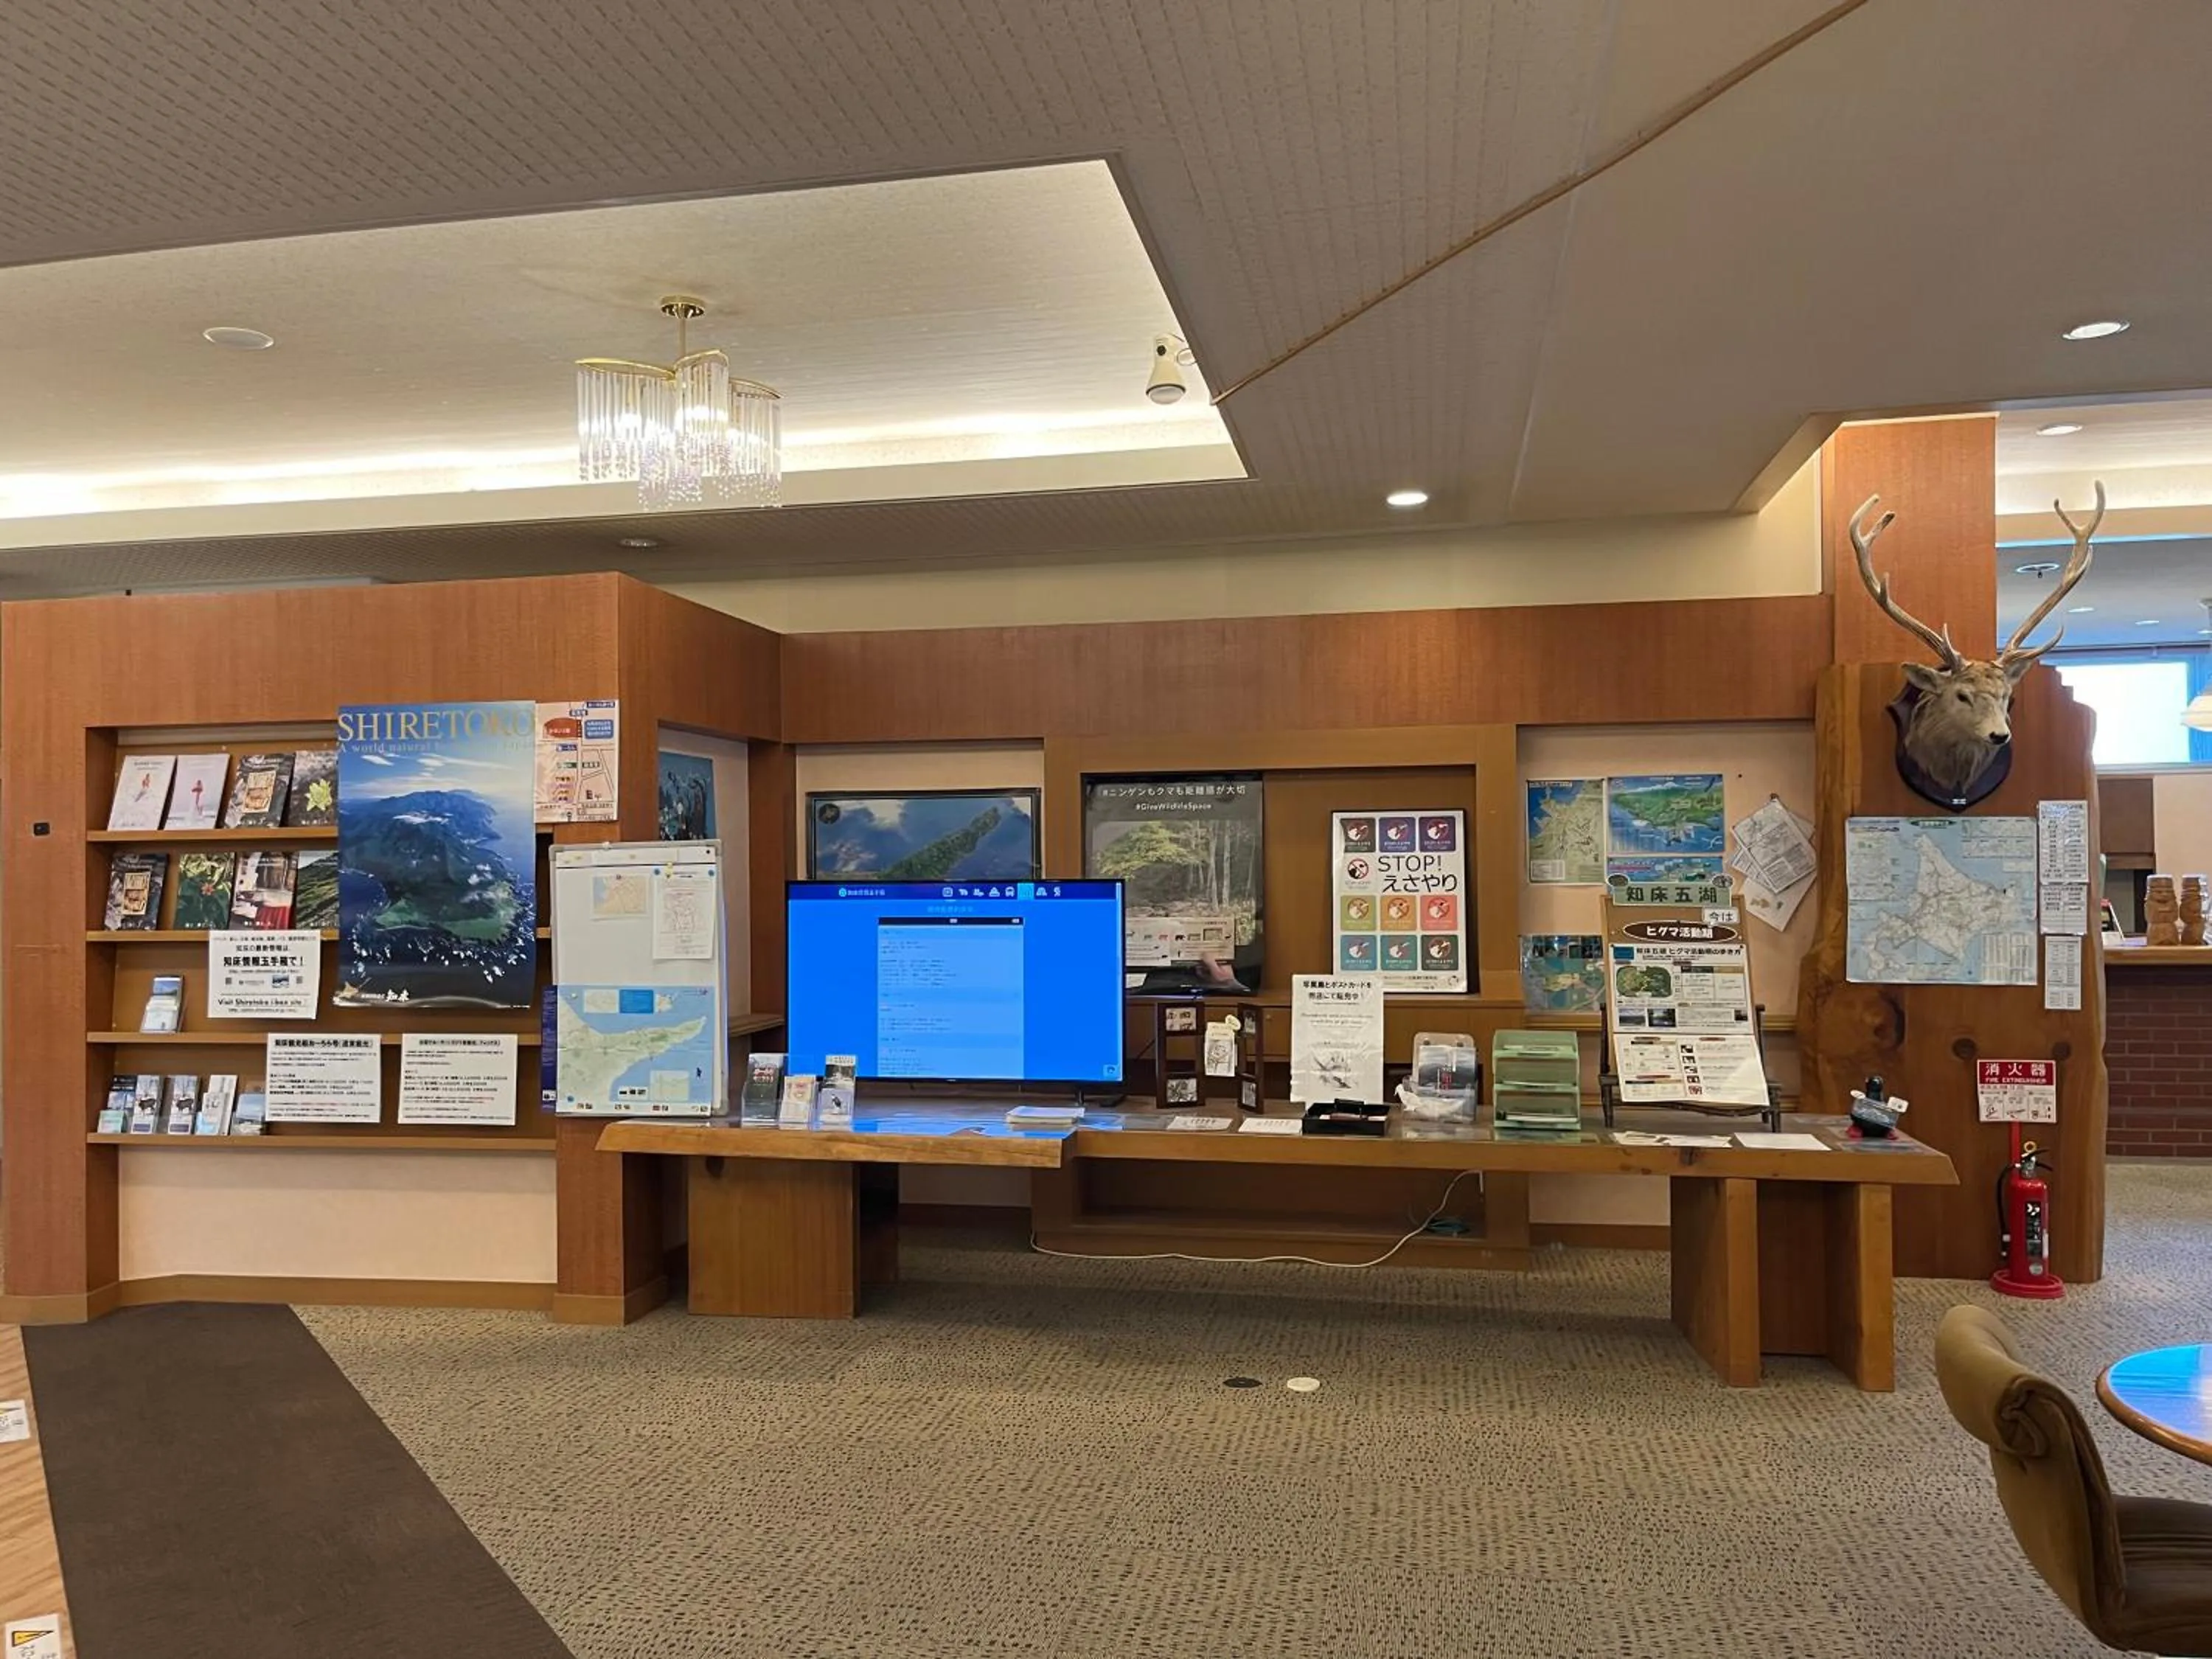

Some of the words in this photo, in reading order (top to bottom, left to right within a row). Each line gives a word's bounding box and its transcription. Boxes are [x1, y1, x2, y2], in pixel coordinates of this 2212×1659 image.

[1378, 855, 1442, 872] STOP!
[1382, 874, 1458, 892] えさやり
[1626, 886, 1717, 903] 知床五湖
[1709, 911, 1733, 922] 今は
[1646, 925, 1713, 939] ヒグマ活動期
[1985, 1062, 2046, 1077] 消火器
